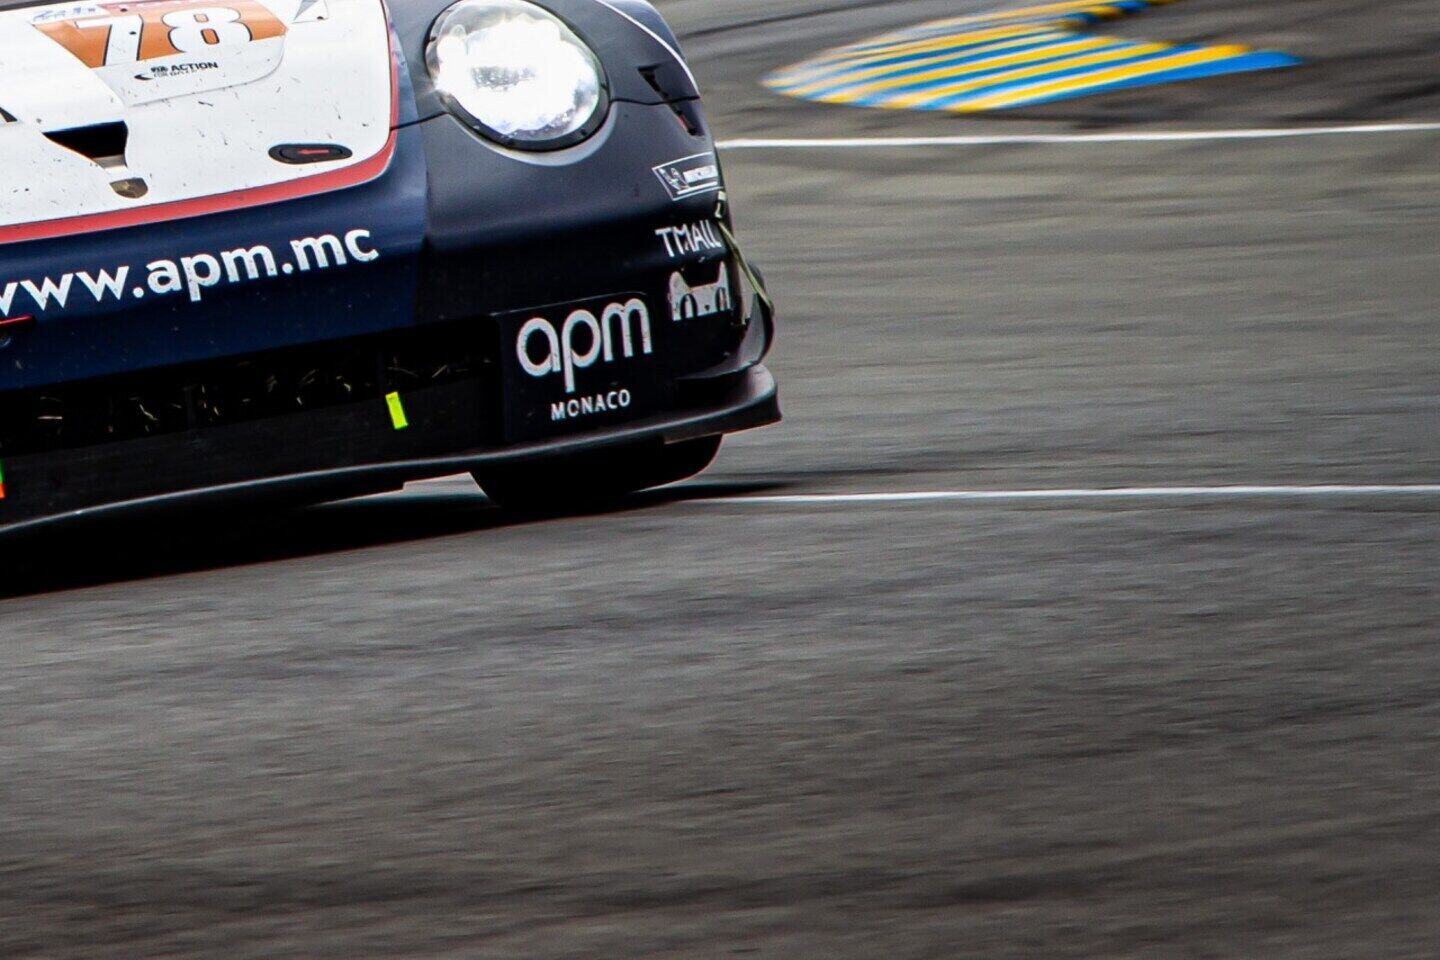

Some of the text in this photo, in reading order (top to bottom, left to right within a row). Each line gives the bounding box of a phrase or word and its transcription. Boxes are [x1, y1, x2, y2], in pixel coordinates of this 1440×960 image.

[73, 5, 254, 67] 78
[171, 61, 219, 72] ACTION
[654, 219, 723, 258] TMALL
[516, 297, 653, 394] apm
[550, 389, 632, 421] MONACO
